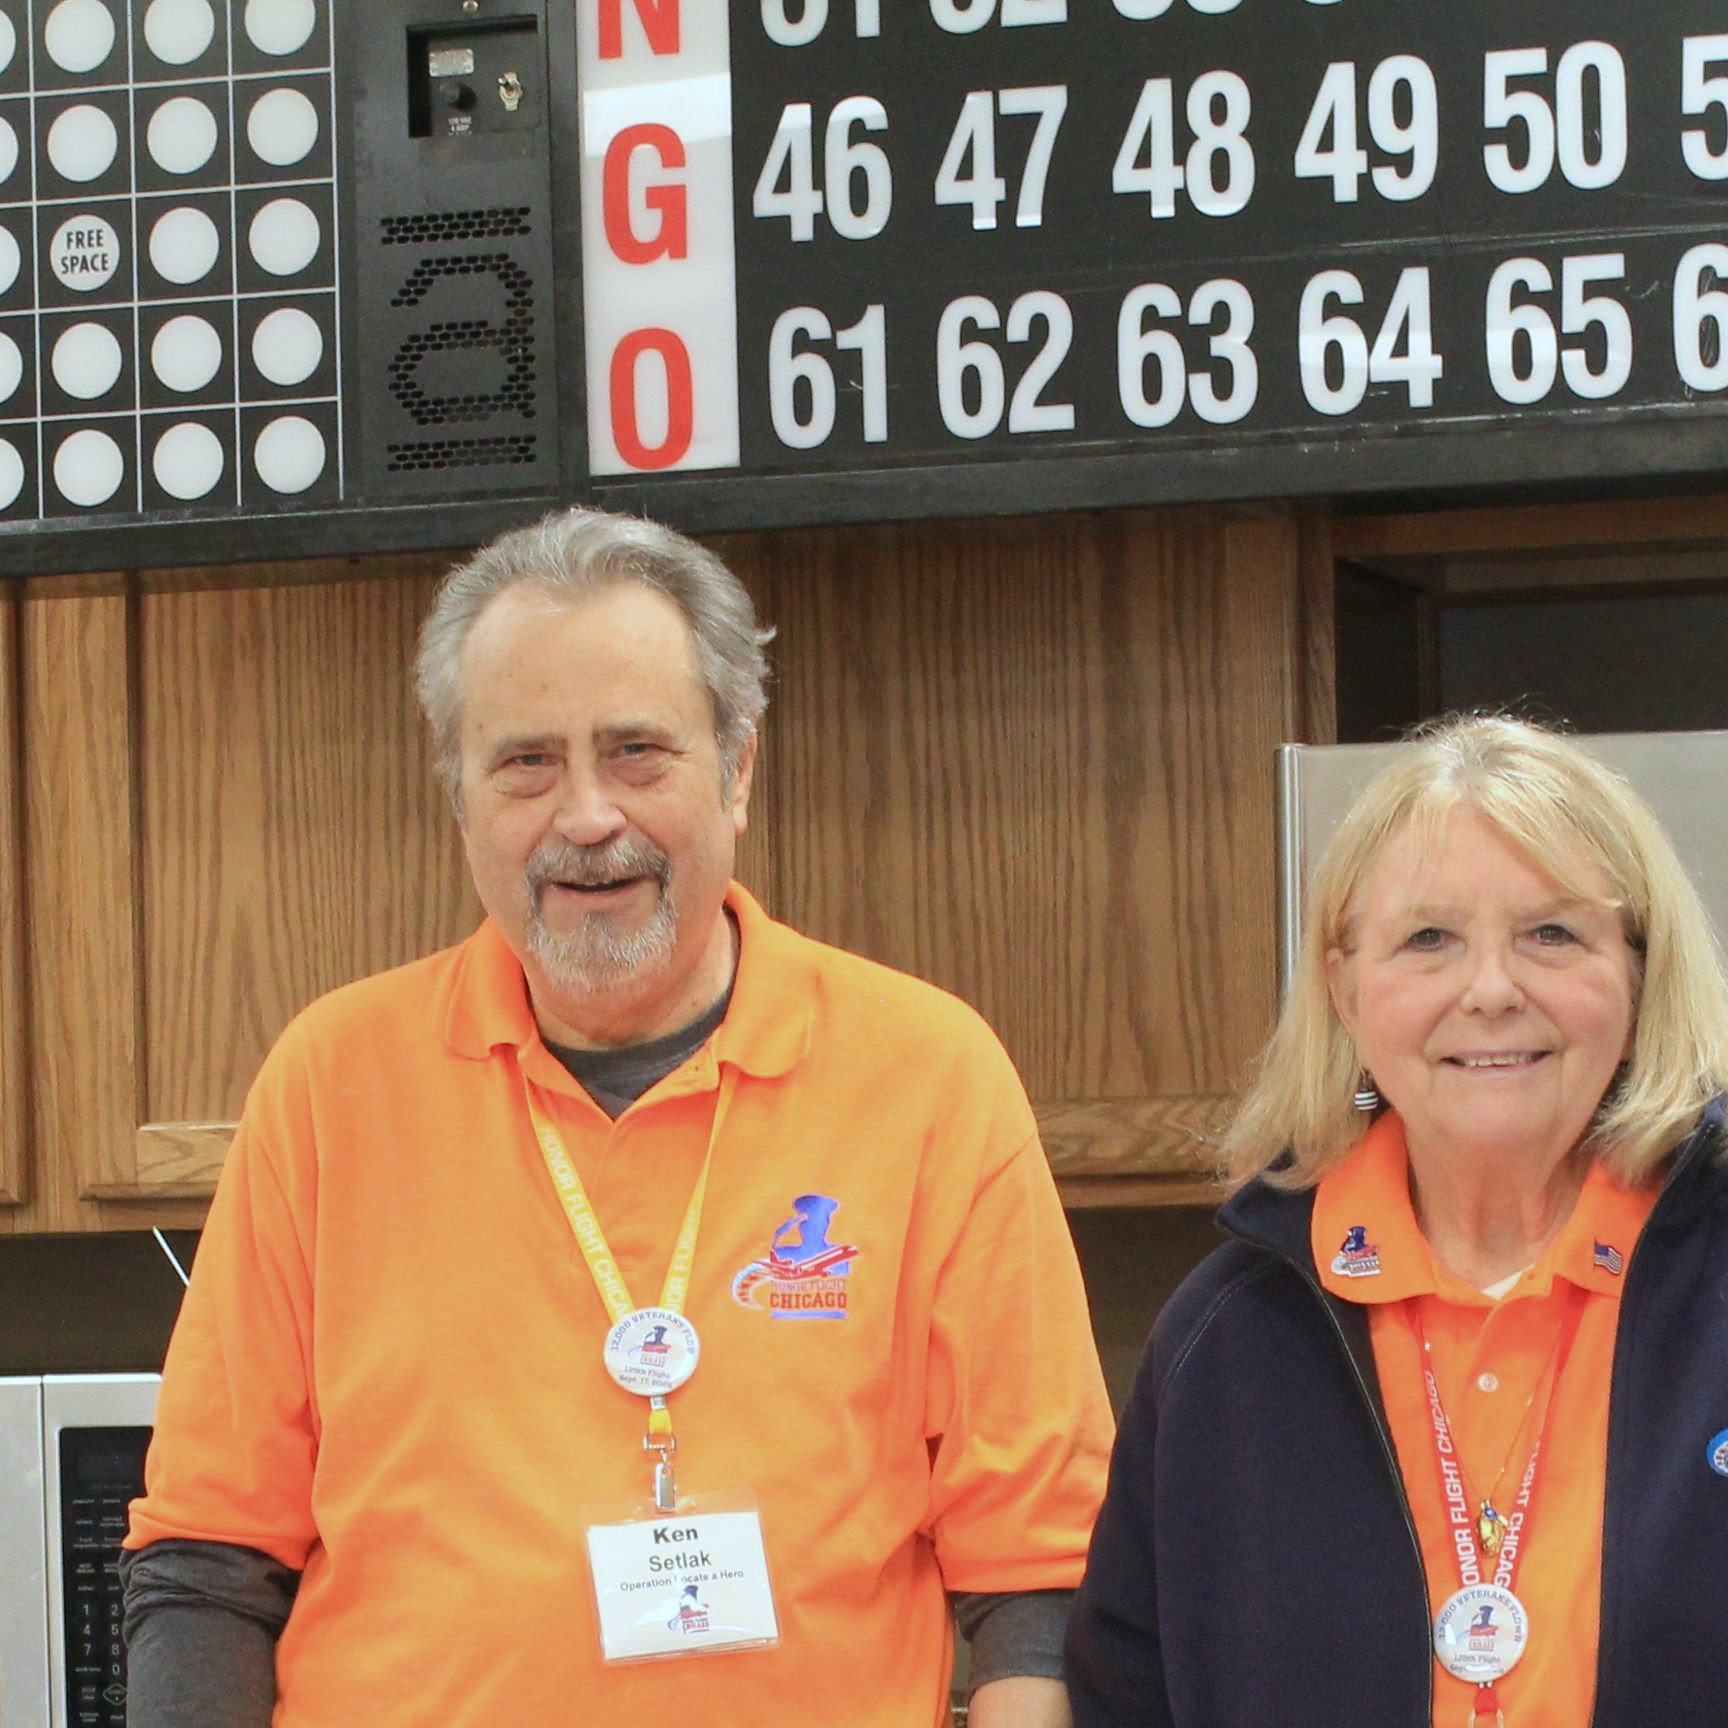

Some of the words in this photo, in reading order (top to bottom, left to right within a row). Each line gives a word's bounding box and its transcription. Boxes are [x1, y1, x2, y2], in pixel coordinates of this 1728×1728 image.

[603, 124, 688, 265] G
[753, 95, 892, 242] 46
[934, 85, 1068, 230] 47
[1112, 70, 1255, 219] 48
[1294, 54, 1439, 203] 49
[1483, 40, 1628, 194] 50
[66, 228, 104, 250] FREE
[61, 252, 109, 275] SPACE
[768, 304, 888, 449] 61
[936, 290, 1075, 439] 62
[1117, 278, 1259, 428] 63
[1298, 266, 1443, 415] 64
[1485, 252, 1633, 404] 65
[539, 1126, 578, 1189] HONOR
[565, 1192, 607, 1255] FLIGHT
[593, 1257, 632, 1318] CHICA
[769, 1291, 848, 1309] CHICAGO
[631, 1310, 683, 1330] VETERANS
[682, 1328, 696, 1354] FLOW
[1424, 1371, 1453, 1454] CHICAGO
[1440, 1459, 1469, 1524] FLIGHT
[653, 1526, 699, 1545] Ken
[648, 1550, 713, 1573] Setlak
[1454, 1528, 1481, 1586] ONOR
[1493, 1512, 1525, 1588] CHICAG
[619, 1576, 672, 1593] Operation
[720, 1569, 745, 1581] Hero
[1456, 1589, 1511, 1607] VETERANS
[83, 1604, 90, 1617] 1
[111, 1604, 119, 1617] 2
[83, 1624, 91, 1636] 4
[111, 1624, 119, 1636] 5
[83, 1643, 91, 1656] 7
[111, 1643, 120, 1656] 8
[112, 1663, 120, 1676] 0
